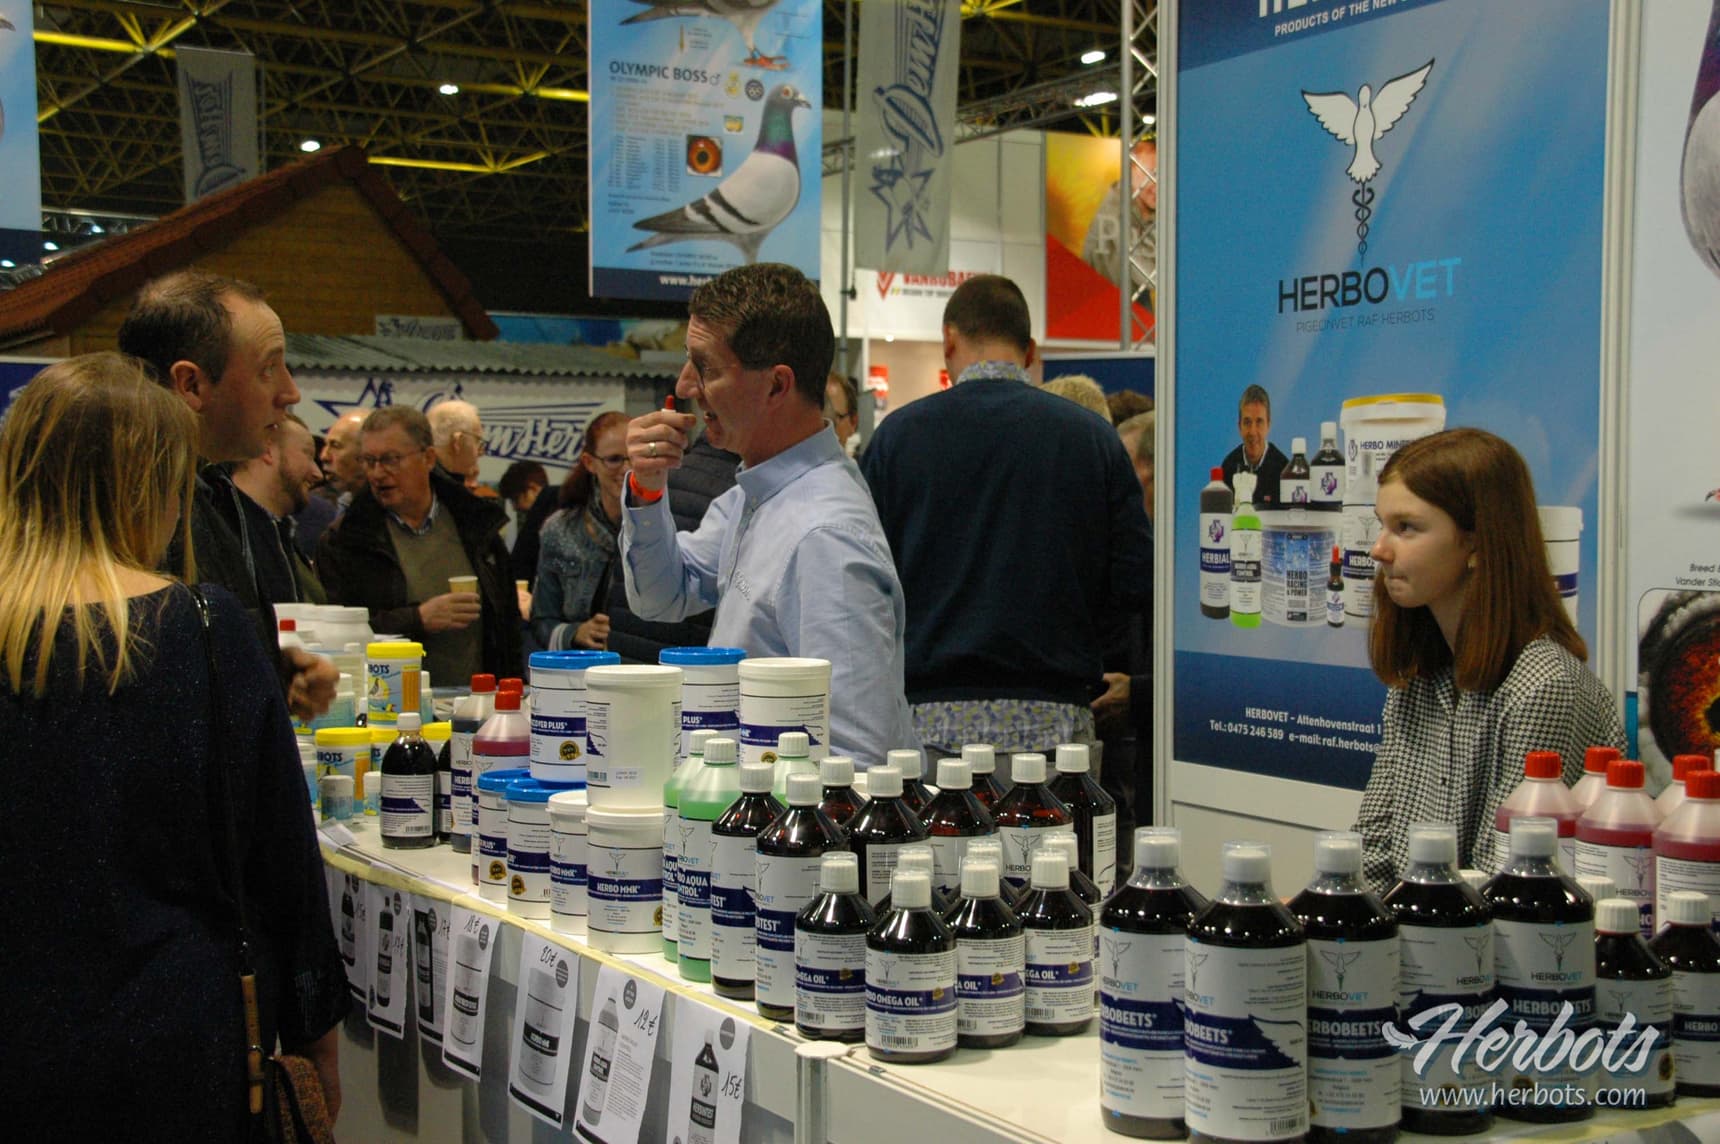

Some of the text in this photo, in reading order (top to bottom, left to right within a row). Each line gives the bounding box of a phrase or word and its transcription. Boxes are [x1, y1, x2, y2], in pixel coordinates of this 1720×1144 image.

[1274, 11, 1329, 37] PRODUCTS
[1331, 7, 1346, 21] OF
[1350, 1, 1370, 16] THE
[609, 60, 708, 84] OLYMPIC BOSS
[1278, 257, 1462, 314] HERBOVET
[1296, 307, 1435, 333] PIGEONVET RAF HERBOTS
[1360, 440, 1384, 450] HERBO
[1245, 706, 1289, 724] HERBOVET
[1297, 713, 1375, 735] Attenhovenstraat
[1250, 726, 1266, 738] 246
[1267, 730, 1284, 741] 589
[686, 876, 709, 887] AQUA
[813, 972, 827, 985] OIL
[877, 992, 904, 1007] OMEGA
[904, 996, 920, 1007] OIL
[1312, 990, 1369, 1001] HERBOVET
